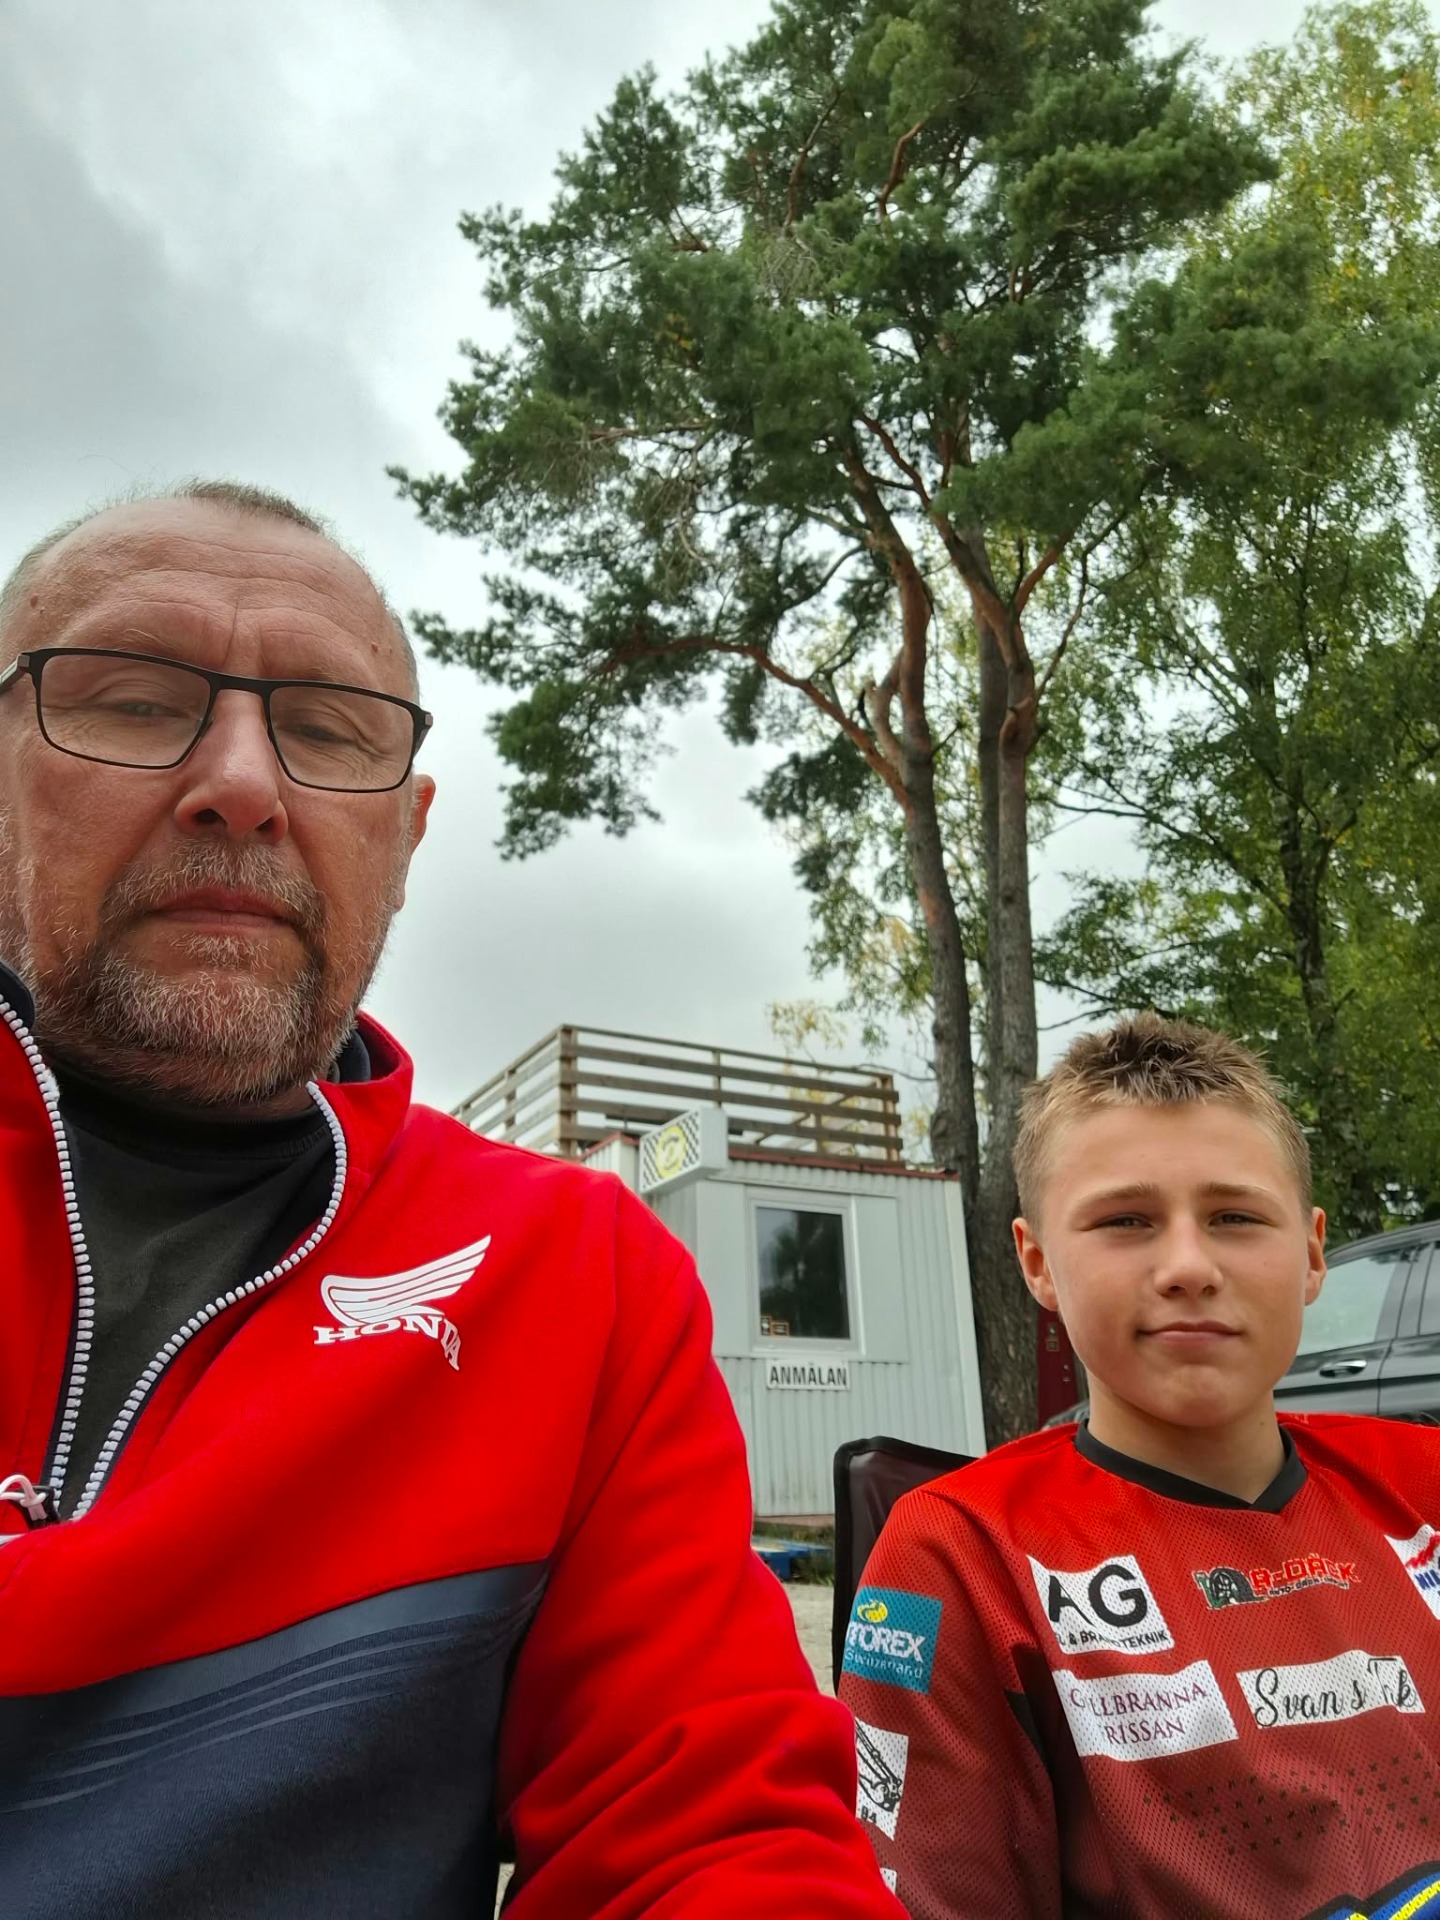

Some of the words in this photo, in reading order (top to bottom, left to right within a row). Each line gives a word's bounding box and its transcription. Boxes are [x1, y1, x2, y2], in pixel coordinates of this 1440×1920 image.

[313, 1314, 462, 1371] HONDA
[1048, 1564, 1148, 1628] AG
[846, 1621, 926, 1664] TOREX
